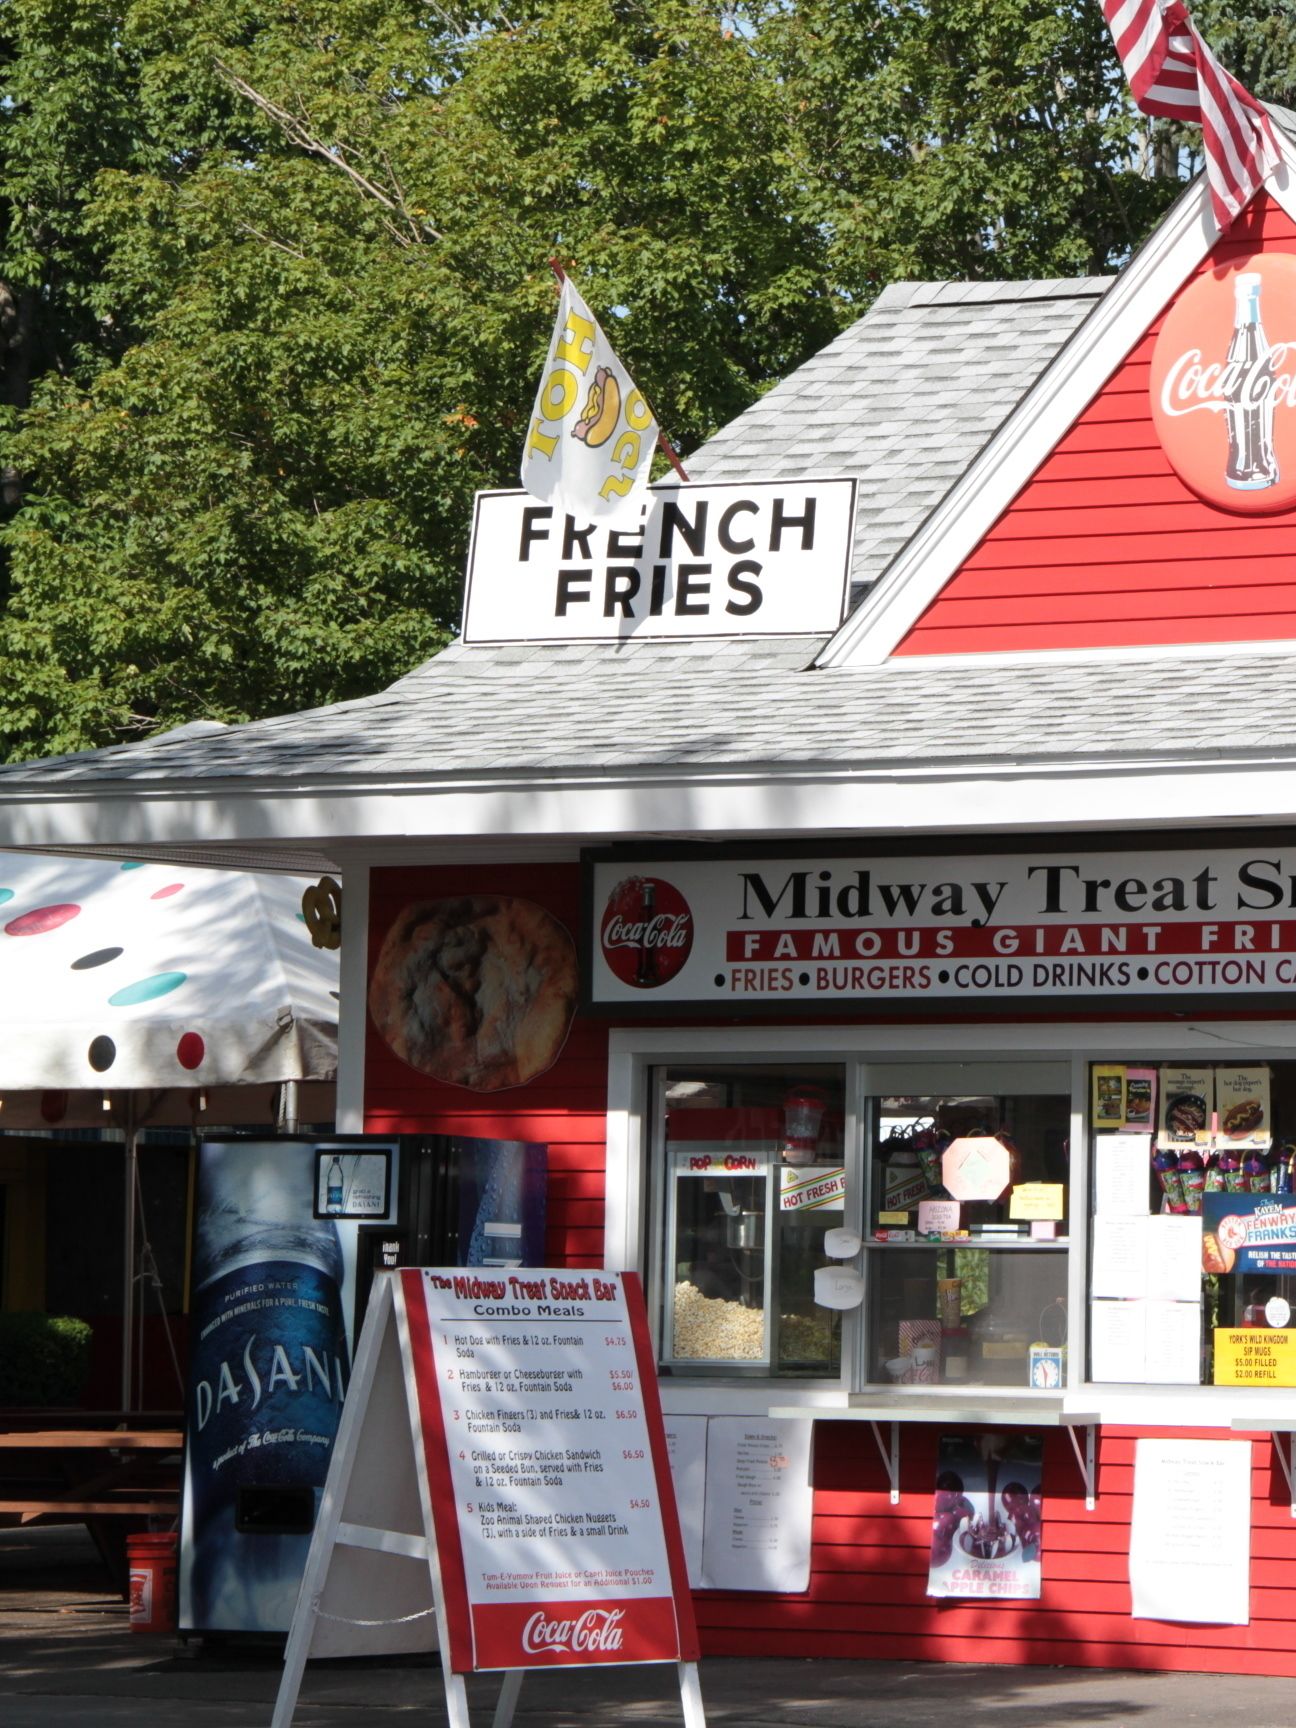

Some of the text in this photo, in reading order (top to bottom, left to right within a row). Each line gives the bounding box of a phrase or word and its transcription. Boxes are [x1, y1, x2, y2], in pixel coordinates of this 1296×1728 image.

[519, 497, 817, 562] FRENCH
[555, 559, 763, 618] FRIES
[736, 870, 1008, 929] Midway
[1028, 864, 1218, 914] Treat
[603, 910, 688, 949] Coca-Cola
[745, 929, 955, 959] FAMOUS
[992, 925, 1161, 954] GIANT
[731, 968, 794, 992] FRIES
[815, 965, 931, 990] BURGERS
[954, 963, 1023, 989] COLD
[1032, 961, 1131, 987] DRINKS
[1153, 958, 1266, 985] COTTON
[690, 1153, 756, 1171] POP CORN
[783, 1191, 803, 1209] HOT
[806, 1179, 837, 1201] FRESH
[1254, 1203, 1283, 1218] KAYEM
[1247, 1213, 1296, 1230] FENWAY
[382, 1241, 400, 1253] Thank
[1271, 1251, 1280, 1259] THE
[224, 1281, 298, 1303] PURIFIED WATER
[431, 1275, 617, 1301] The Midway Treat Snack Bar
[234, 1299, 261, 1316] MINERALS
[262, 1298, 274, 1307] FOR
[474, 1305, 585, 1316] Combo Meals
[454, 1335, 584, 1346] Hot Dog with Fries & 12 Fountain
[1229, 1335, 1288, 1344] YORK'S WILD KINGDOM
[456, 1349, 475, 1358] Soda
[1243, 1346, 1271, 1356] SIP MUGS
[1235, 1358, 1277, 1367] $5.00 FILLED
[448, 1369, 583, 1380] 2 Hamburger Cheeseburger with
[1235, 1370, 1277, 1378] $2.00 REFILL
[196, 1333, 345, 1432] DASANI
[461, 1382, 573, 1392] Fries & 12 Fountain Soda
[612, 1382, 634, 1391] $6.00
[453, 1409, 593, 1421] 3 Chicken Fingers and 12
[615, 1410, 638, 1419] $6.50
[468, 1422, 522, 1433] Fountain Soda
[459, 1449, 601, 1463] 4 Grilled Crispy Chicken Sandwich
[622, 1449, 645, 1459] $6.50
[491, 1462, 604, 1474] Seeded served with Fries
[484, 1475, 563, 1487] 12 Fountain Soda
[478, 1502, 517, 1513] Kids Meal:
[630, 1499, 650, 1509] $4.50
[480, 1512, 616, 1526] Zoo Animal Shaped Chicken Nuggets
[497, 1524, 629, 1538] with side Fries small Drink
[624, 1568, 654, 1577] Pouches
[951, 1570, 1019, 1582] CARAMEL
[486, 1581, 518, 1590] Available
[540, 1580, 569, 1588] Request
[594, 1577, 630, 1586] Additional
[989, 1582, 1031, 1596] CHIPS
[522, 1608, 626, 1654] Coca-Cola
